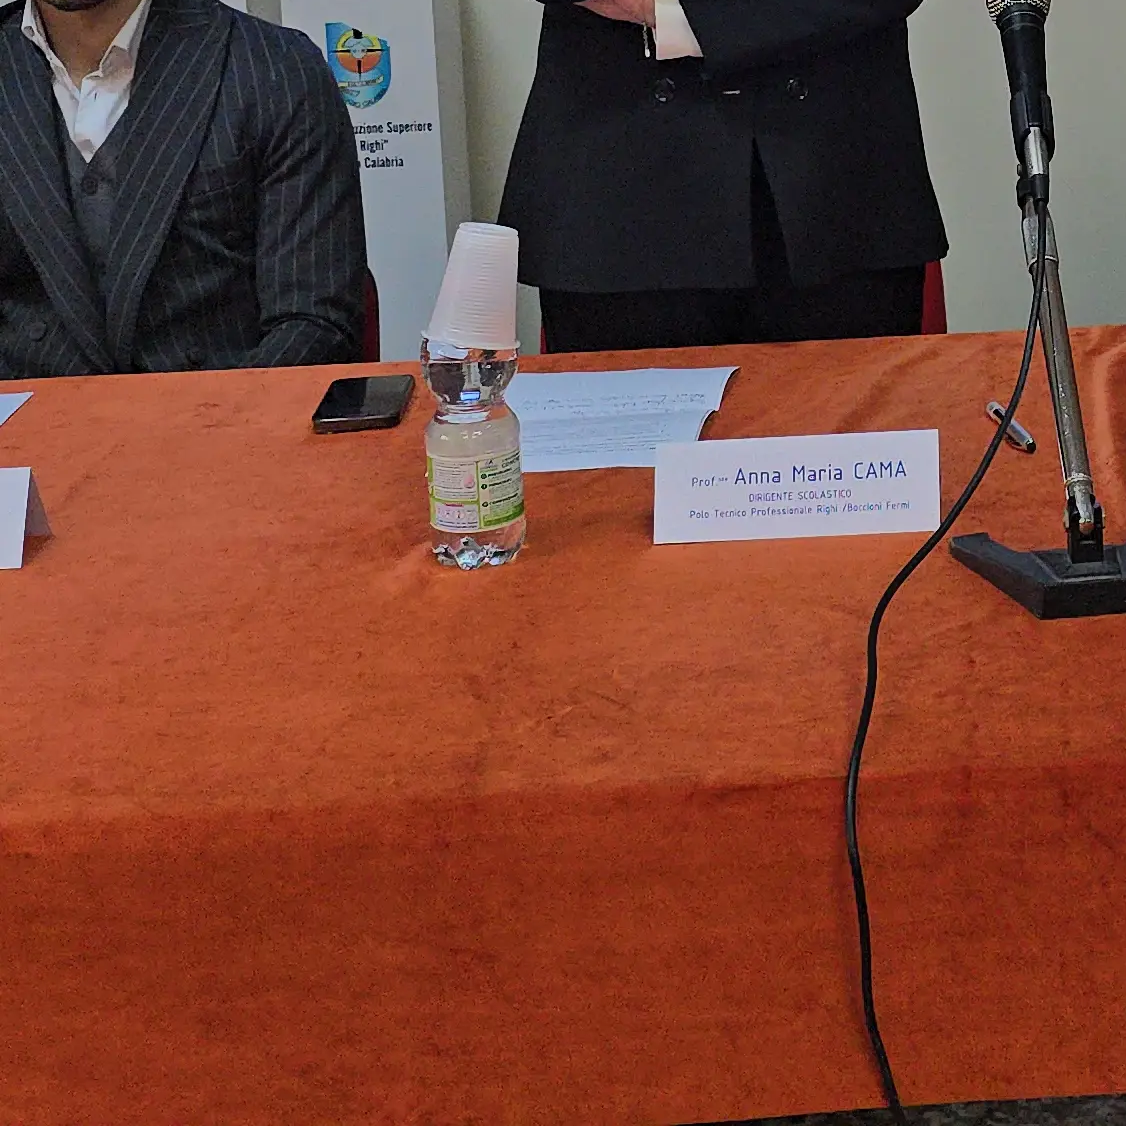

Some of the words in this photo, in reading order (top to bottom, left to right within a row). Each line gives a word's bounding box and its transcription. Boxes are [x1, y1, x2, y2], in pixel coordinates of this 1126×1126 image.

[387, 120, 433, 135] Superiore
[364, 156, 404, 169] Calabria
[734, 467, 782, 485] Anna
[792, 463, 844, 483] Maria
[854, 460, 908, 479] CAMA
[748, 490, 794, 503] DIRIGENTE
[798, 488, 852, 501] SCOLASTICO
[690, 509, 710, 519] Polo
[714, 508, 747, 518] Tecnico
[751, 504, 813, 517] Professionale
[817, 502, 839, 516] Righi
[886, 500, 910, 511] Fermi
